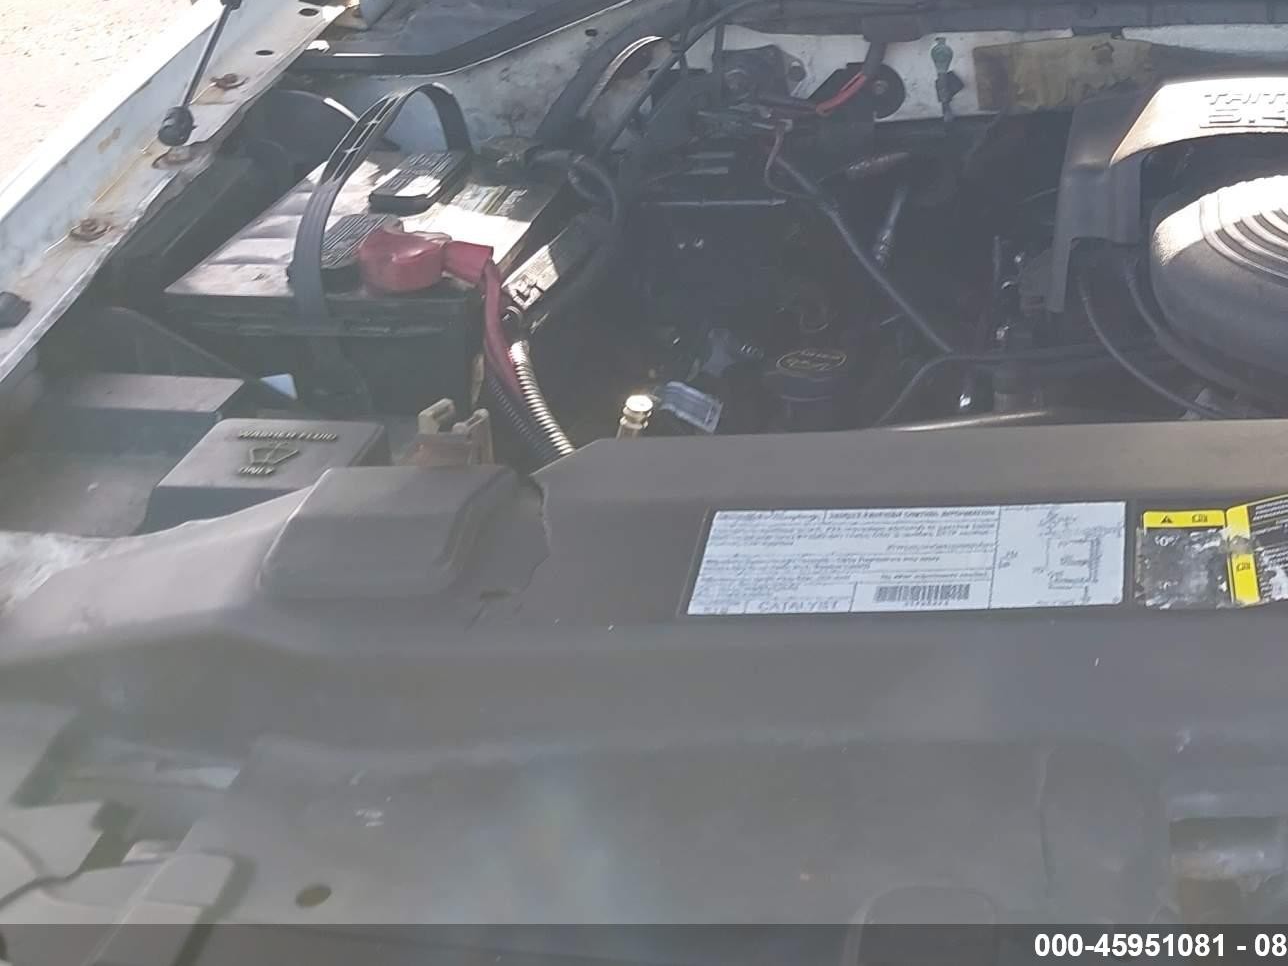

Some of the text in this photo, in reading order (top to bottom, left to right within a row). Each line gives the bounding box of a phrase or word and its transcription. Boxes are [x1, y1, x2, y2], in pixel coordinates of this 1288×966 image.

[239, 430, 338, 442] WASHER FLUID
[239, 465, 275, 476] ONLY
